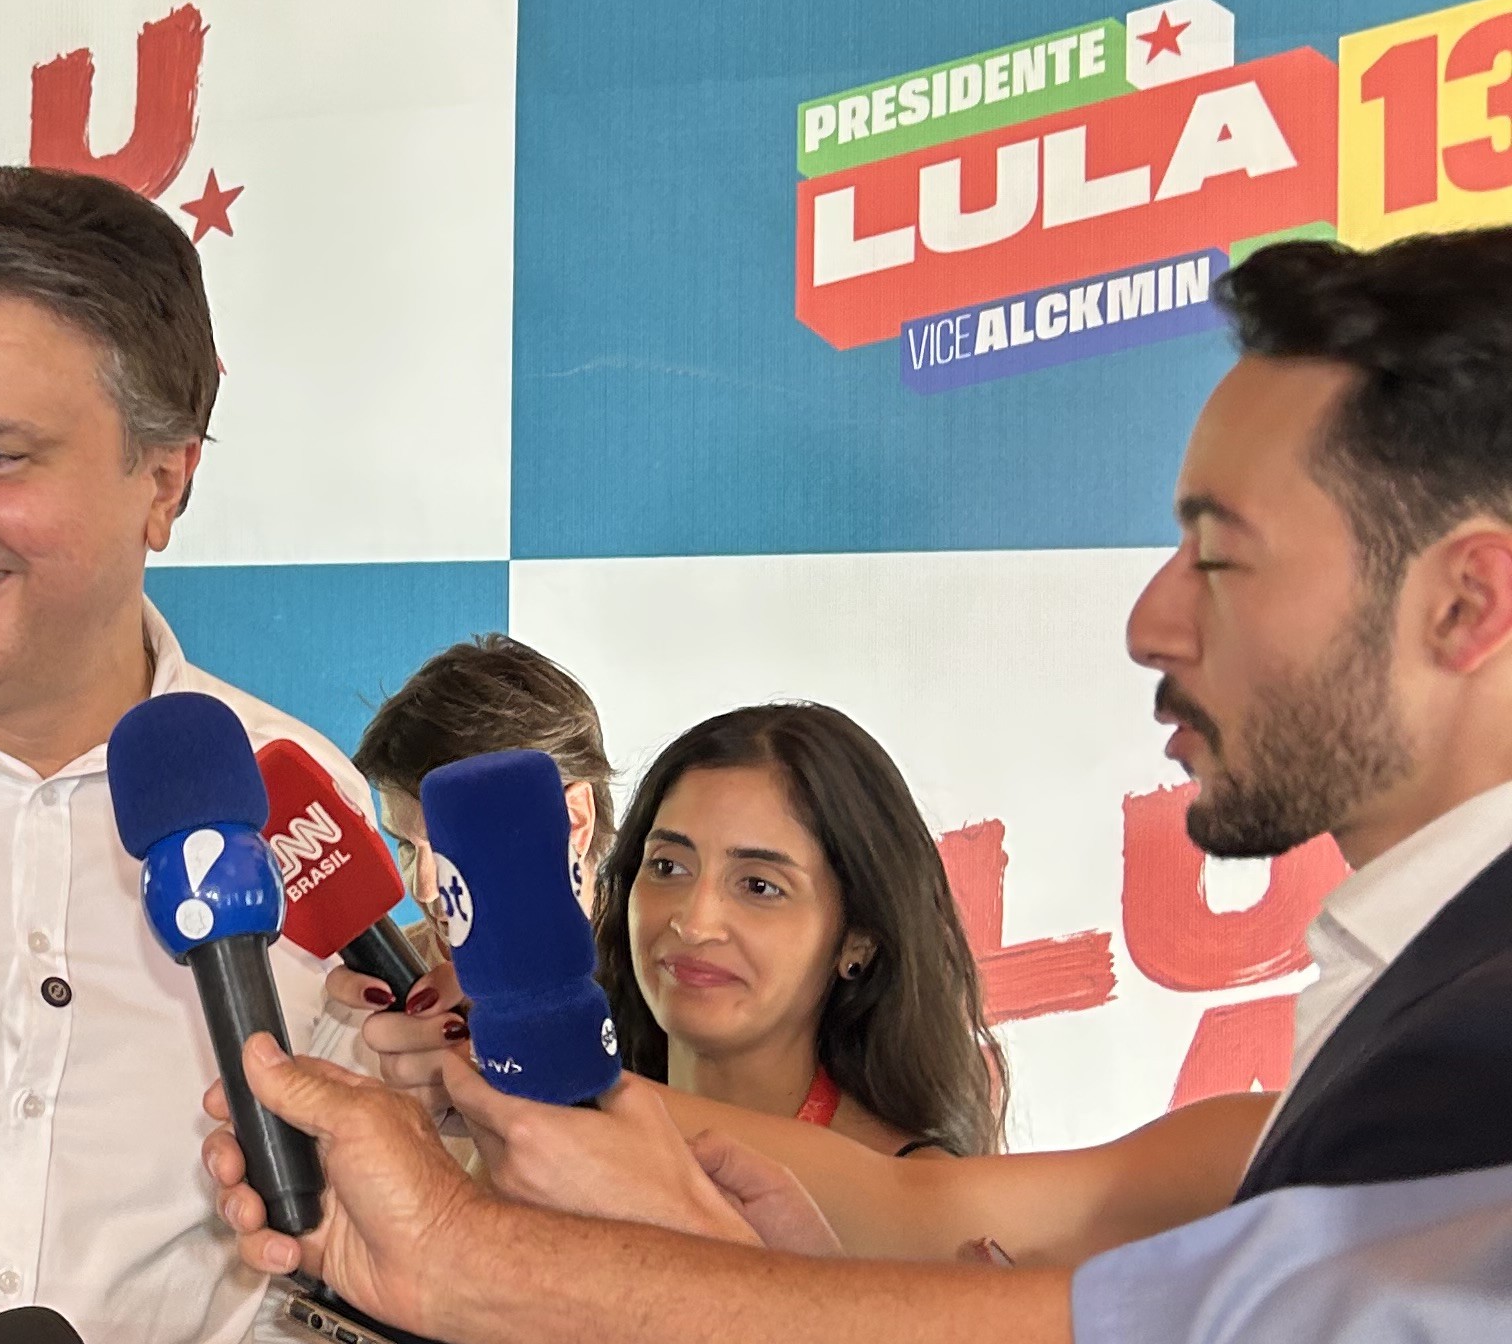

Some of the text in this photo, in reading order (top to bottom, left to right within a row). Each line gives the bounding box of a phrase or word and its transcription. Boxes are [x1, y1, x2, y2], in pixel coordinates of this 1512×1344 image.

[804, 28, 1106, 154] PRESIDENTE
[1361, 12, 1512, 216] 13
[813, 81, 1299, 288] LULA
[908, 256, 1211, 371] VICE ALCKMIN
[286, 849, 352, 903] BRASIL
